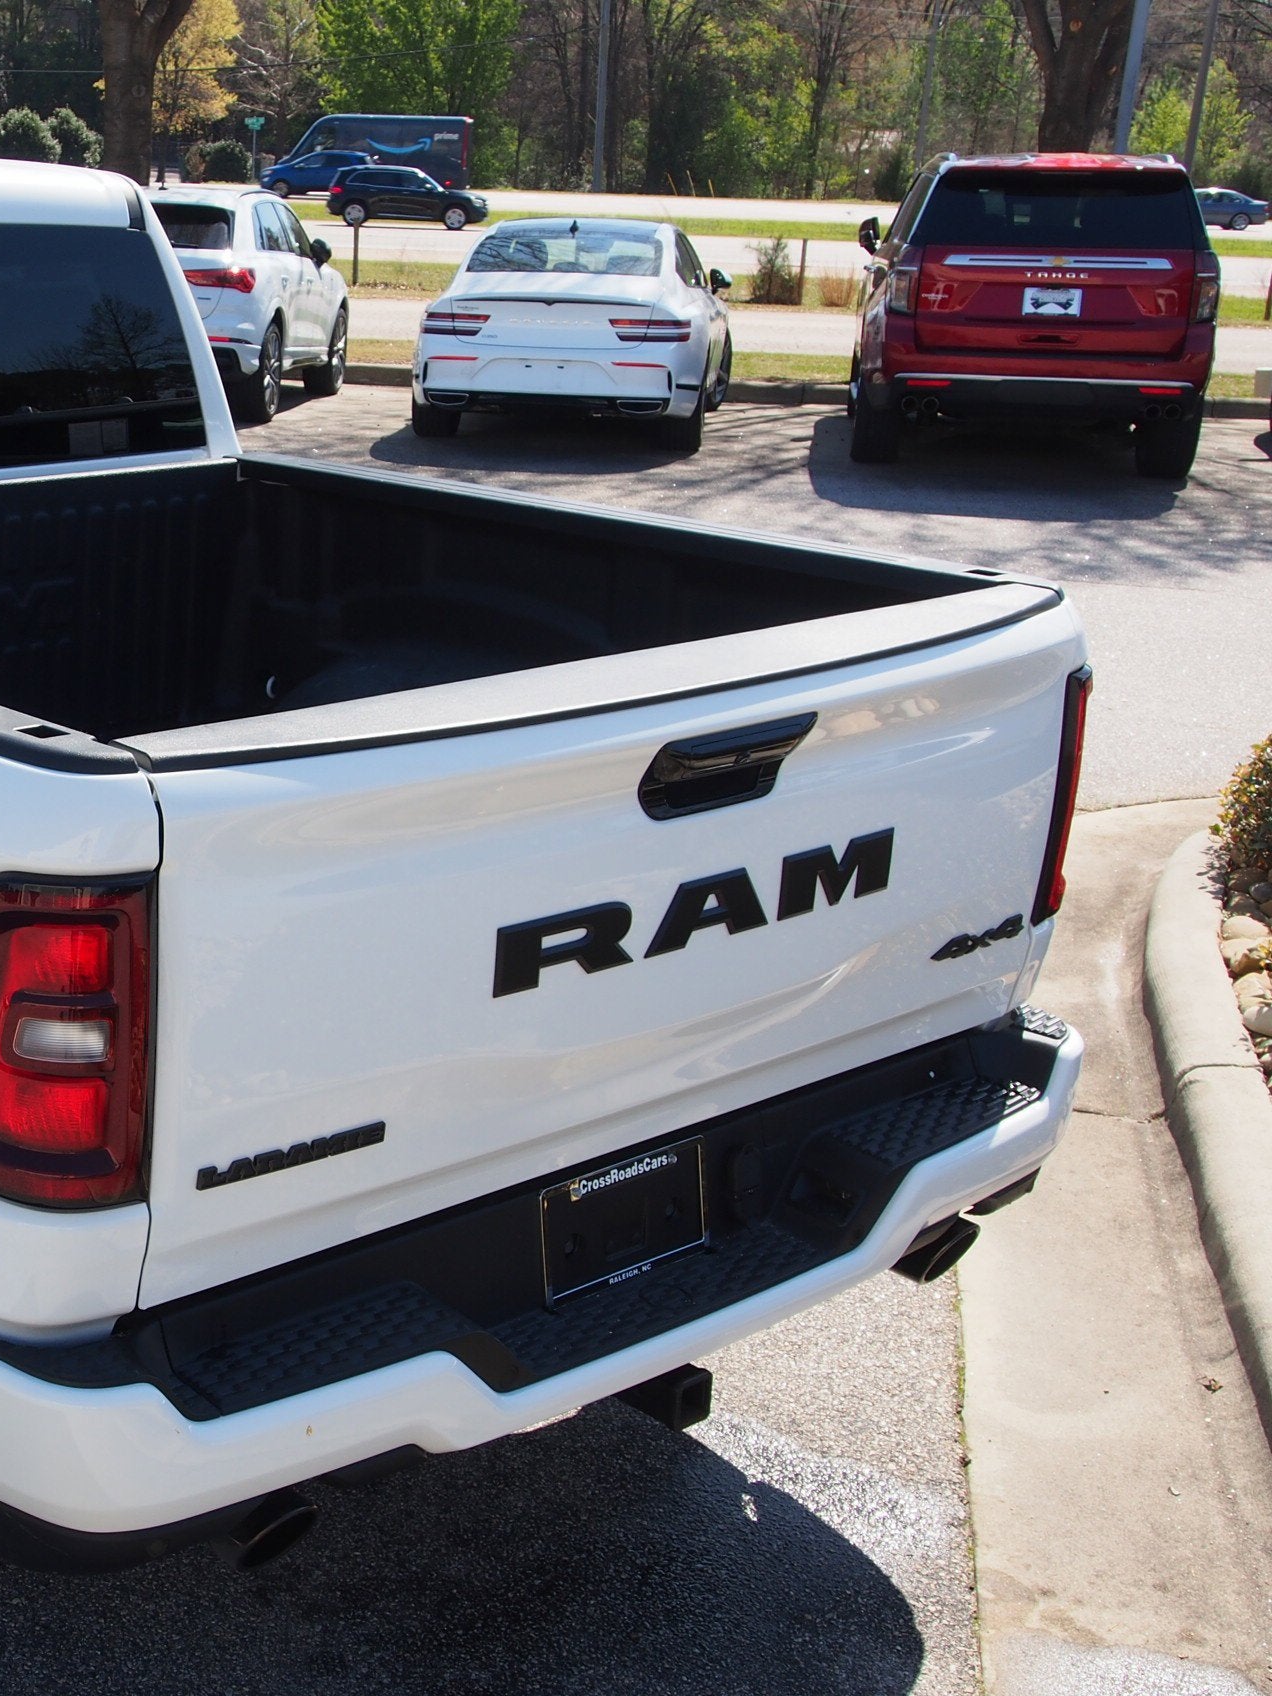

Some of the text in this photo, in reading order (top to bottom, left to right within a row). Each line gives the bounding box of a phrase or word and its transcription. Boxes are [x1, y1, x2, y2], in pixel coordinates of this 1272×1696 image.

[433, 131, 459, 141] prime
[1024, 271, 1089, 279] TAHOE
[493, 827, 895, 998] RAM
[930, 913, 1025, 961] 4x4
[196, 1120, 387, 1191] LARAMIE
[579, 1153, 668, 1195] CrossRoadsCars
[609, 1263, 652, 1285] RALEIGH, NC
